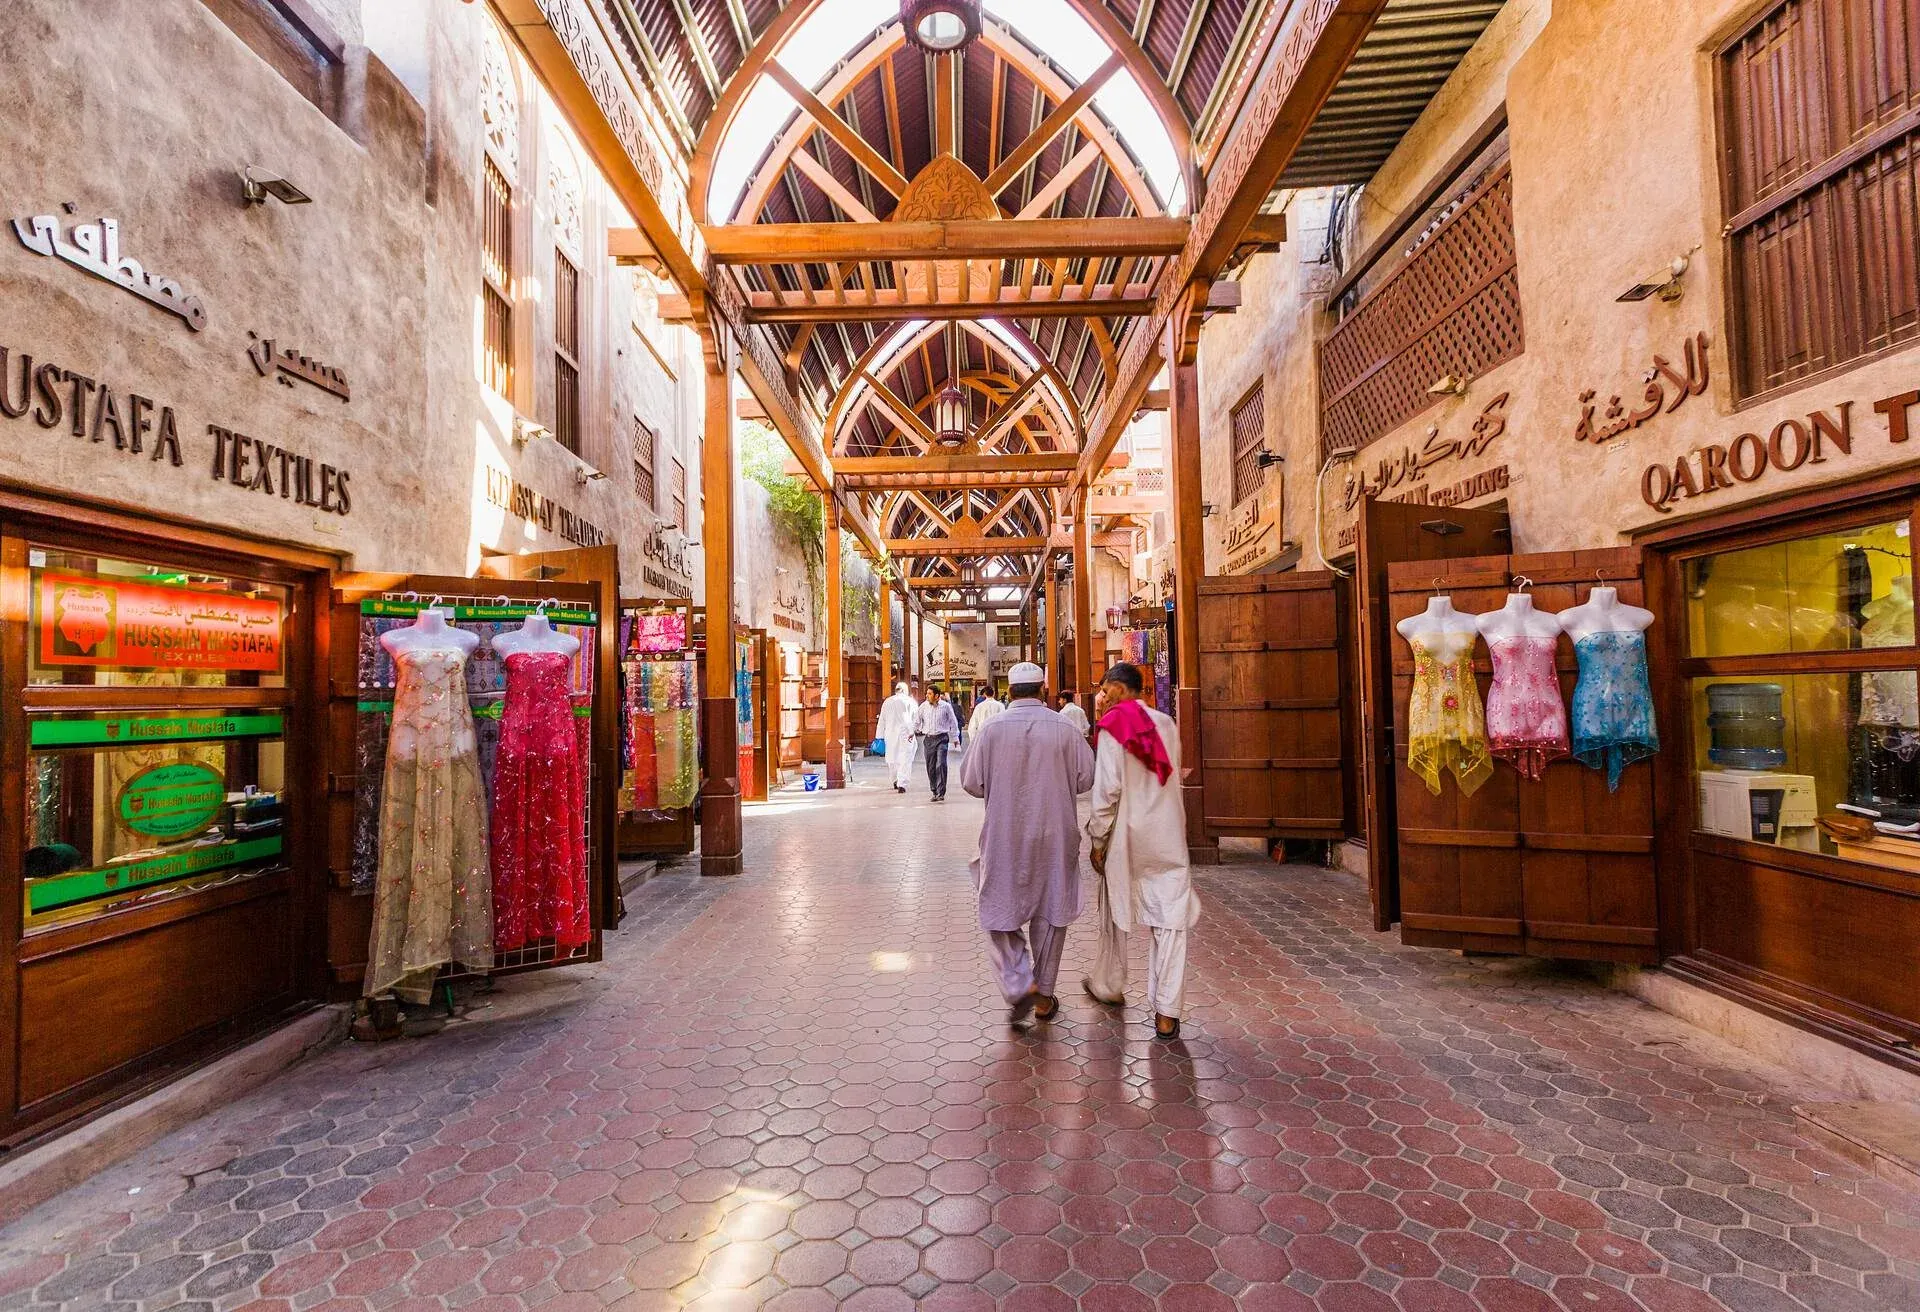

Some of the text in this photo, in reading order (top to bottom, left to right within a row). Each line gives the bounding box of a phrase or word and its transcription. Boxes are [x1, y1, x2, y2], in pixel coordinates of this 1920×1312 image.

[248, 330, 349, 402] حسين
[208, 424, 351, 516] TEXTILES
[1641, 400, 1854, 513] QAROON
[1430, 464, 1510, 507] TRADING
[241, 613, 274, 628] حسين
[124, 623, 200, 649] HUSSAIN
[207, 629, 274, 653] MUSTAFA
[153, 651, 226, 663] TEXTILES
[130, 720, 236, 736] Hussain Mustafa
[128, 850, 235, 882] Hussain Mustafa
